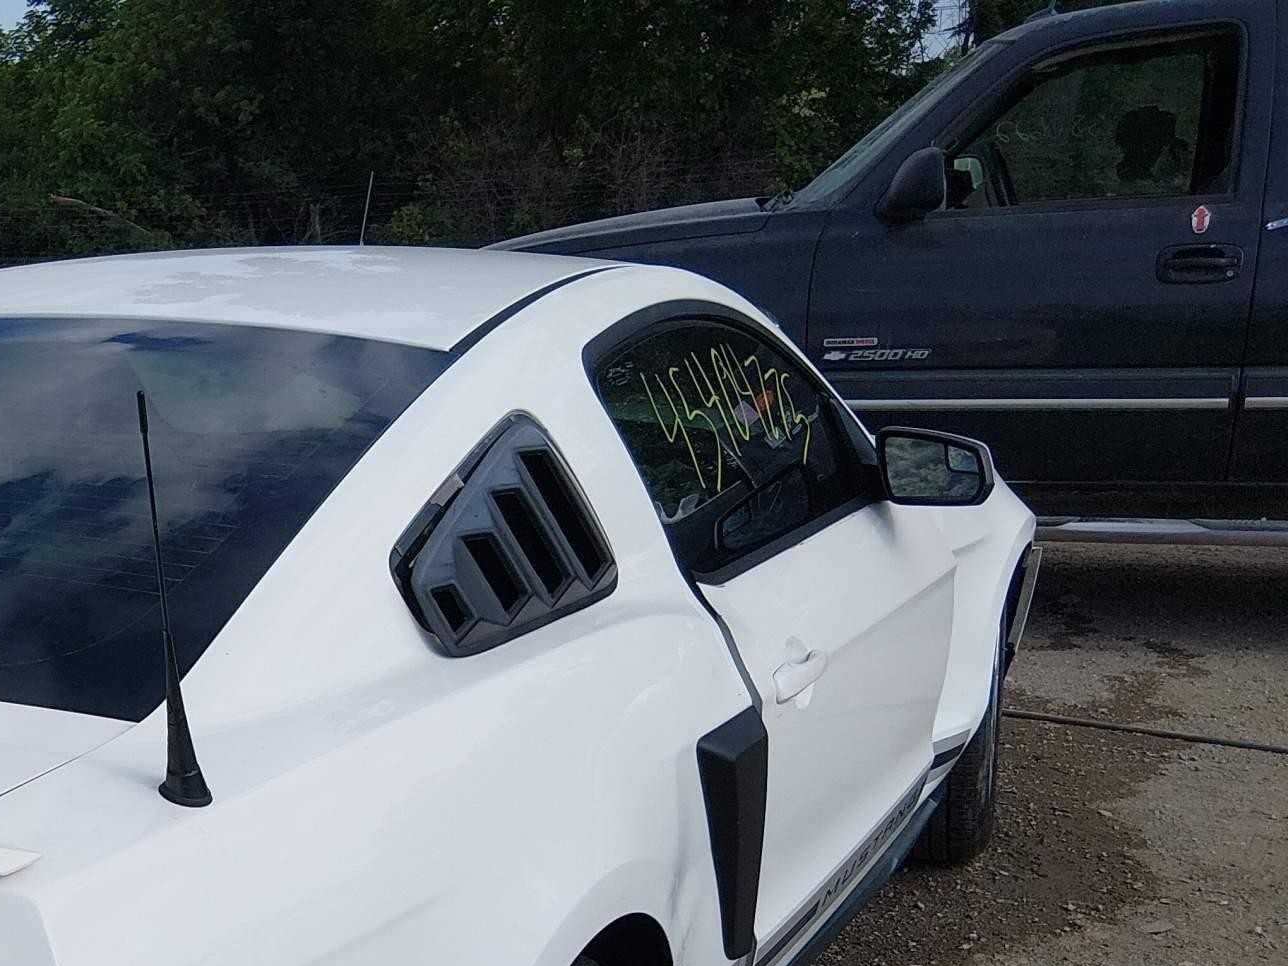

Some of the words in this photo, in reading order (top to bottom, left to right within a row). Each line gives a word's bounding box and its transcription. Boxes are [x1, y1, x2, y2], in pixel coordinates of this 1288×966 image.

[848, 350, 905, 361] 2500
[905, 350, 929, 360] HD
[822, 788, 919, 907] MUSTANG
